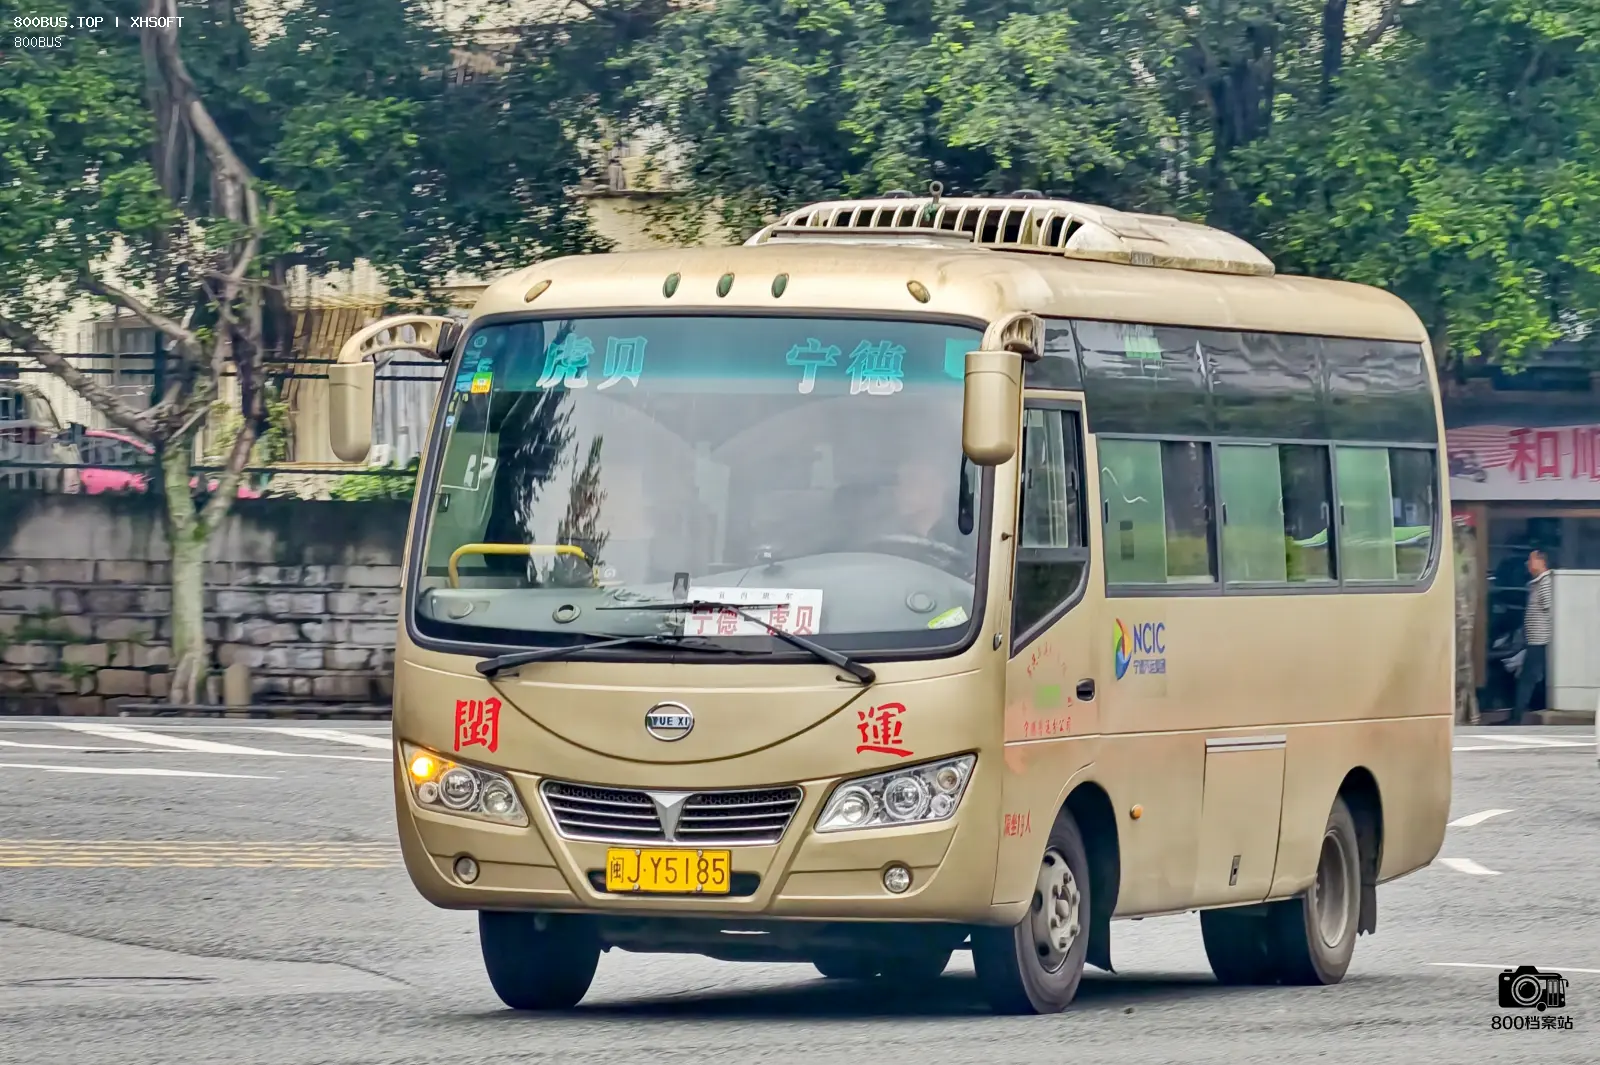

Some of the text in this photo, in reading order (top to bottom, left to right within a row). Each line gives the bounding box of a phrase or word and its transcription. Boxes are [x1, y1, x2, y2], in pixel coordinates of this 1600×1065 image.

[535, 333, 907, 395] 虎贝 宁德
[1133, 622, 1166, 655] NCIC
[652, 716, 688, 726] YUE XI
[856, 702, 914, 757] 運
